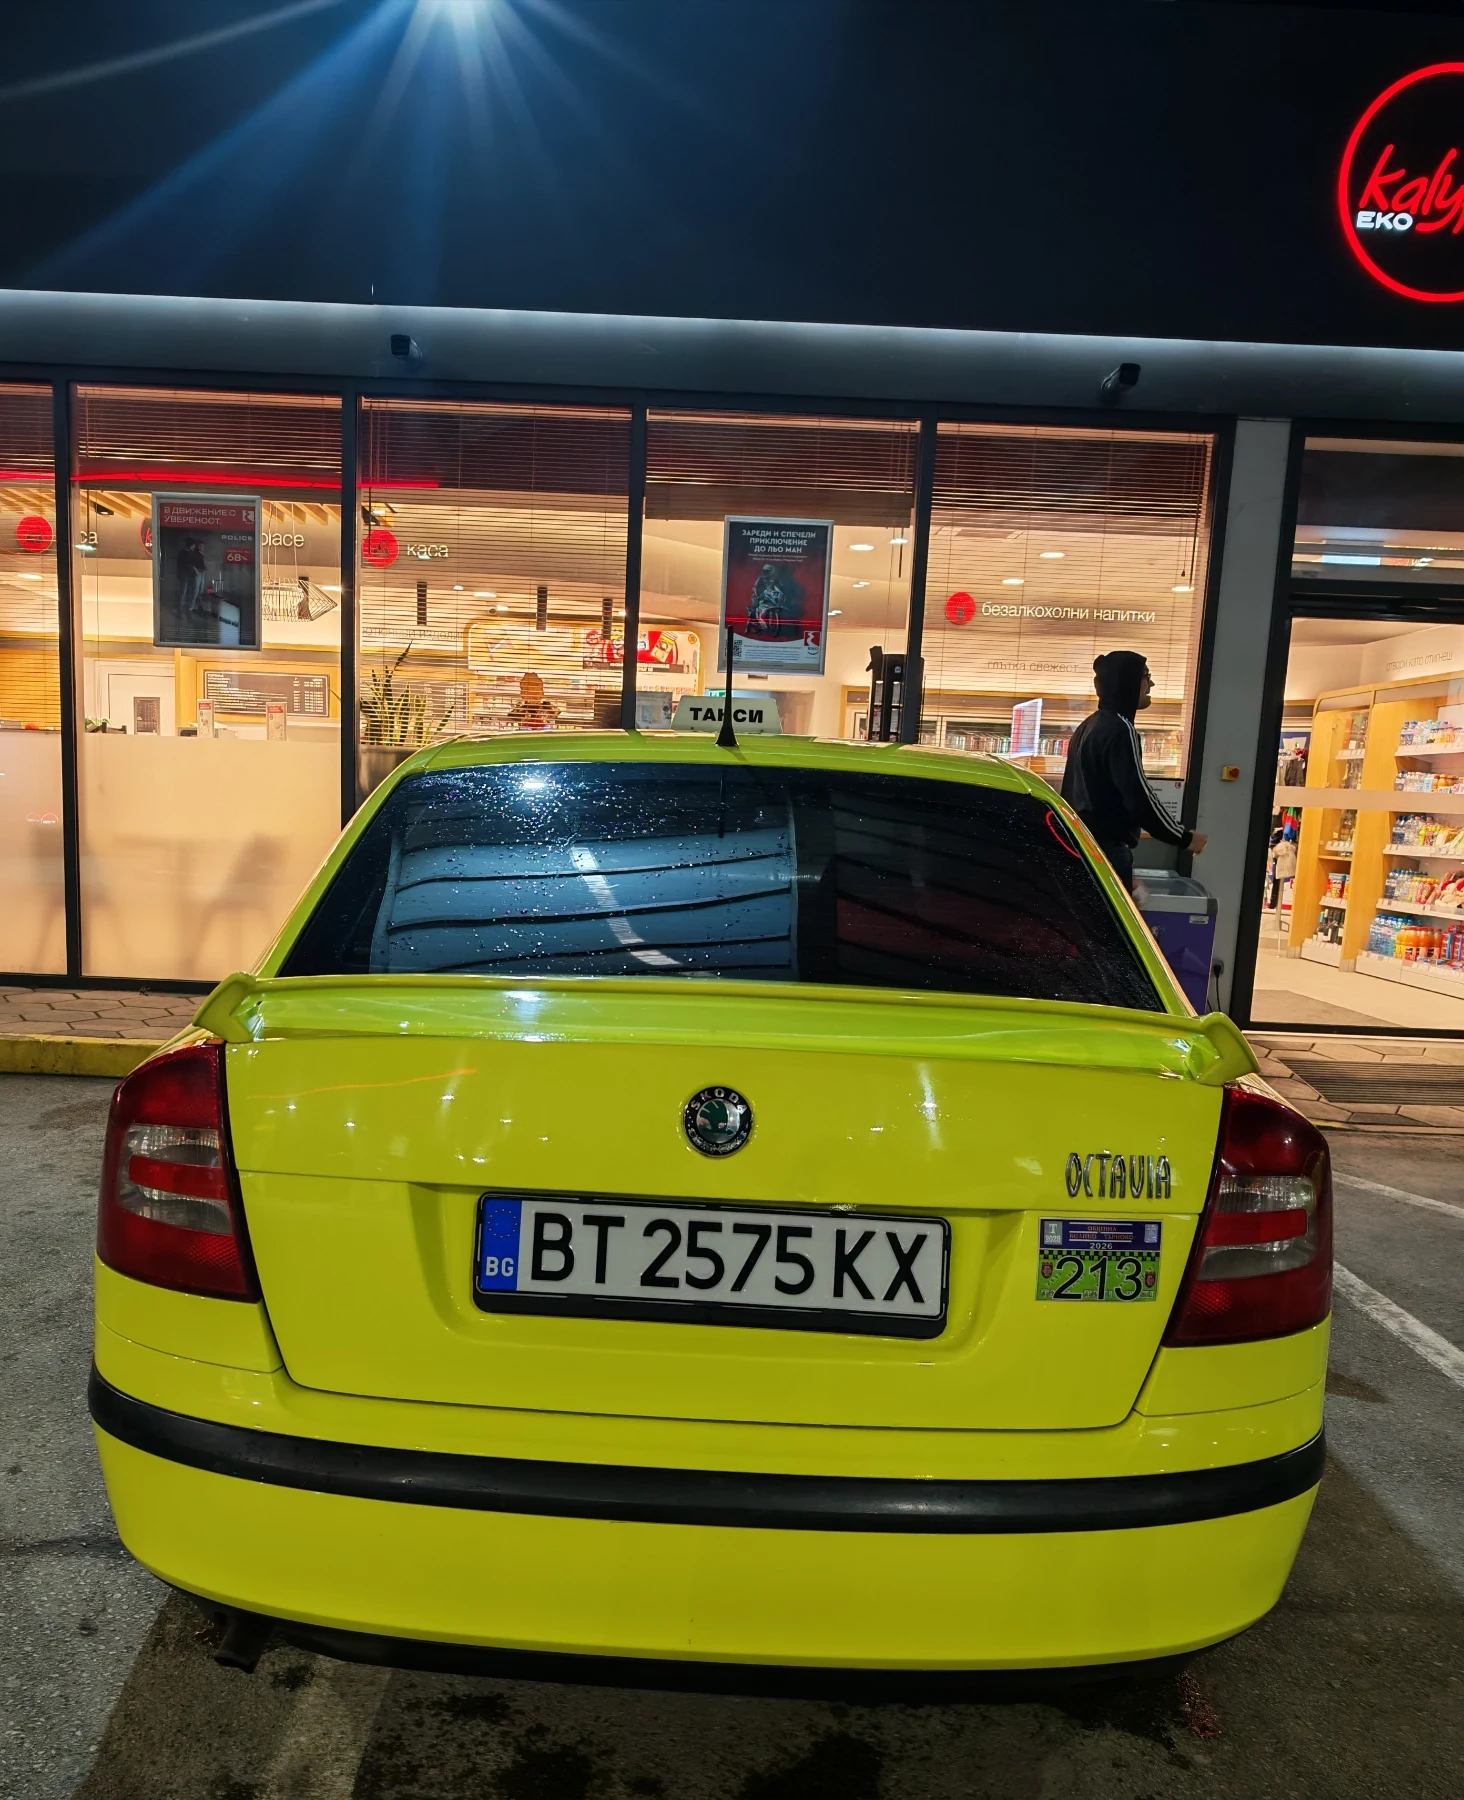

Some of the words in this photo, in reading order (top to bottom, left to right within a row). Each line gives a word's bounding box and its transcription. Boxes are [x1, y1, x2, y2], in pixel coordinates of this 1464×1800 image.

[1359, 143, 1464, 235] kaly
[1356, 210, 1413, 231] EKO
[163, 506, 171, 515] В
[171, 507, 228, 517] ДВИЖЕНИЕ
[221, 534, 253, 542] POLICE
[741, 529, 772, 538] ЗАРЕДИ
[781, 531, 816, 539] СПЕЧЕЛИ
[749, 537, 808, 546] ПРИКЛЮЧЕНИЕ
[406, 543, 450, 558] каса
[754, 545, 767, 553] ДО
[226, 552, 249, 563] 68%
[981, 602, 1089, 620] безалкохолни
[1093, 608, 1156, 623] напитки
[1029, 662, 1080, 673] свежест
[1408, 656, 1424, 668] като
[1065, 1152, 1172, 1200] OCTAVIA
[1048, 1223, 1058, 1234] T
[1089, 1242, 1113, 1250] 2026
[530, 1211, 626, 1284] BT
[639, 1217, 816, 1296] 2575
[832, 1228, 929, 1304] KX
[485, 1256, 515, 1277] BG
[1052, 1255, 1143, 1302] 213
